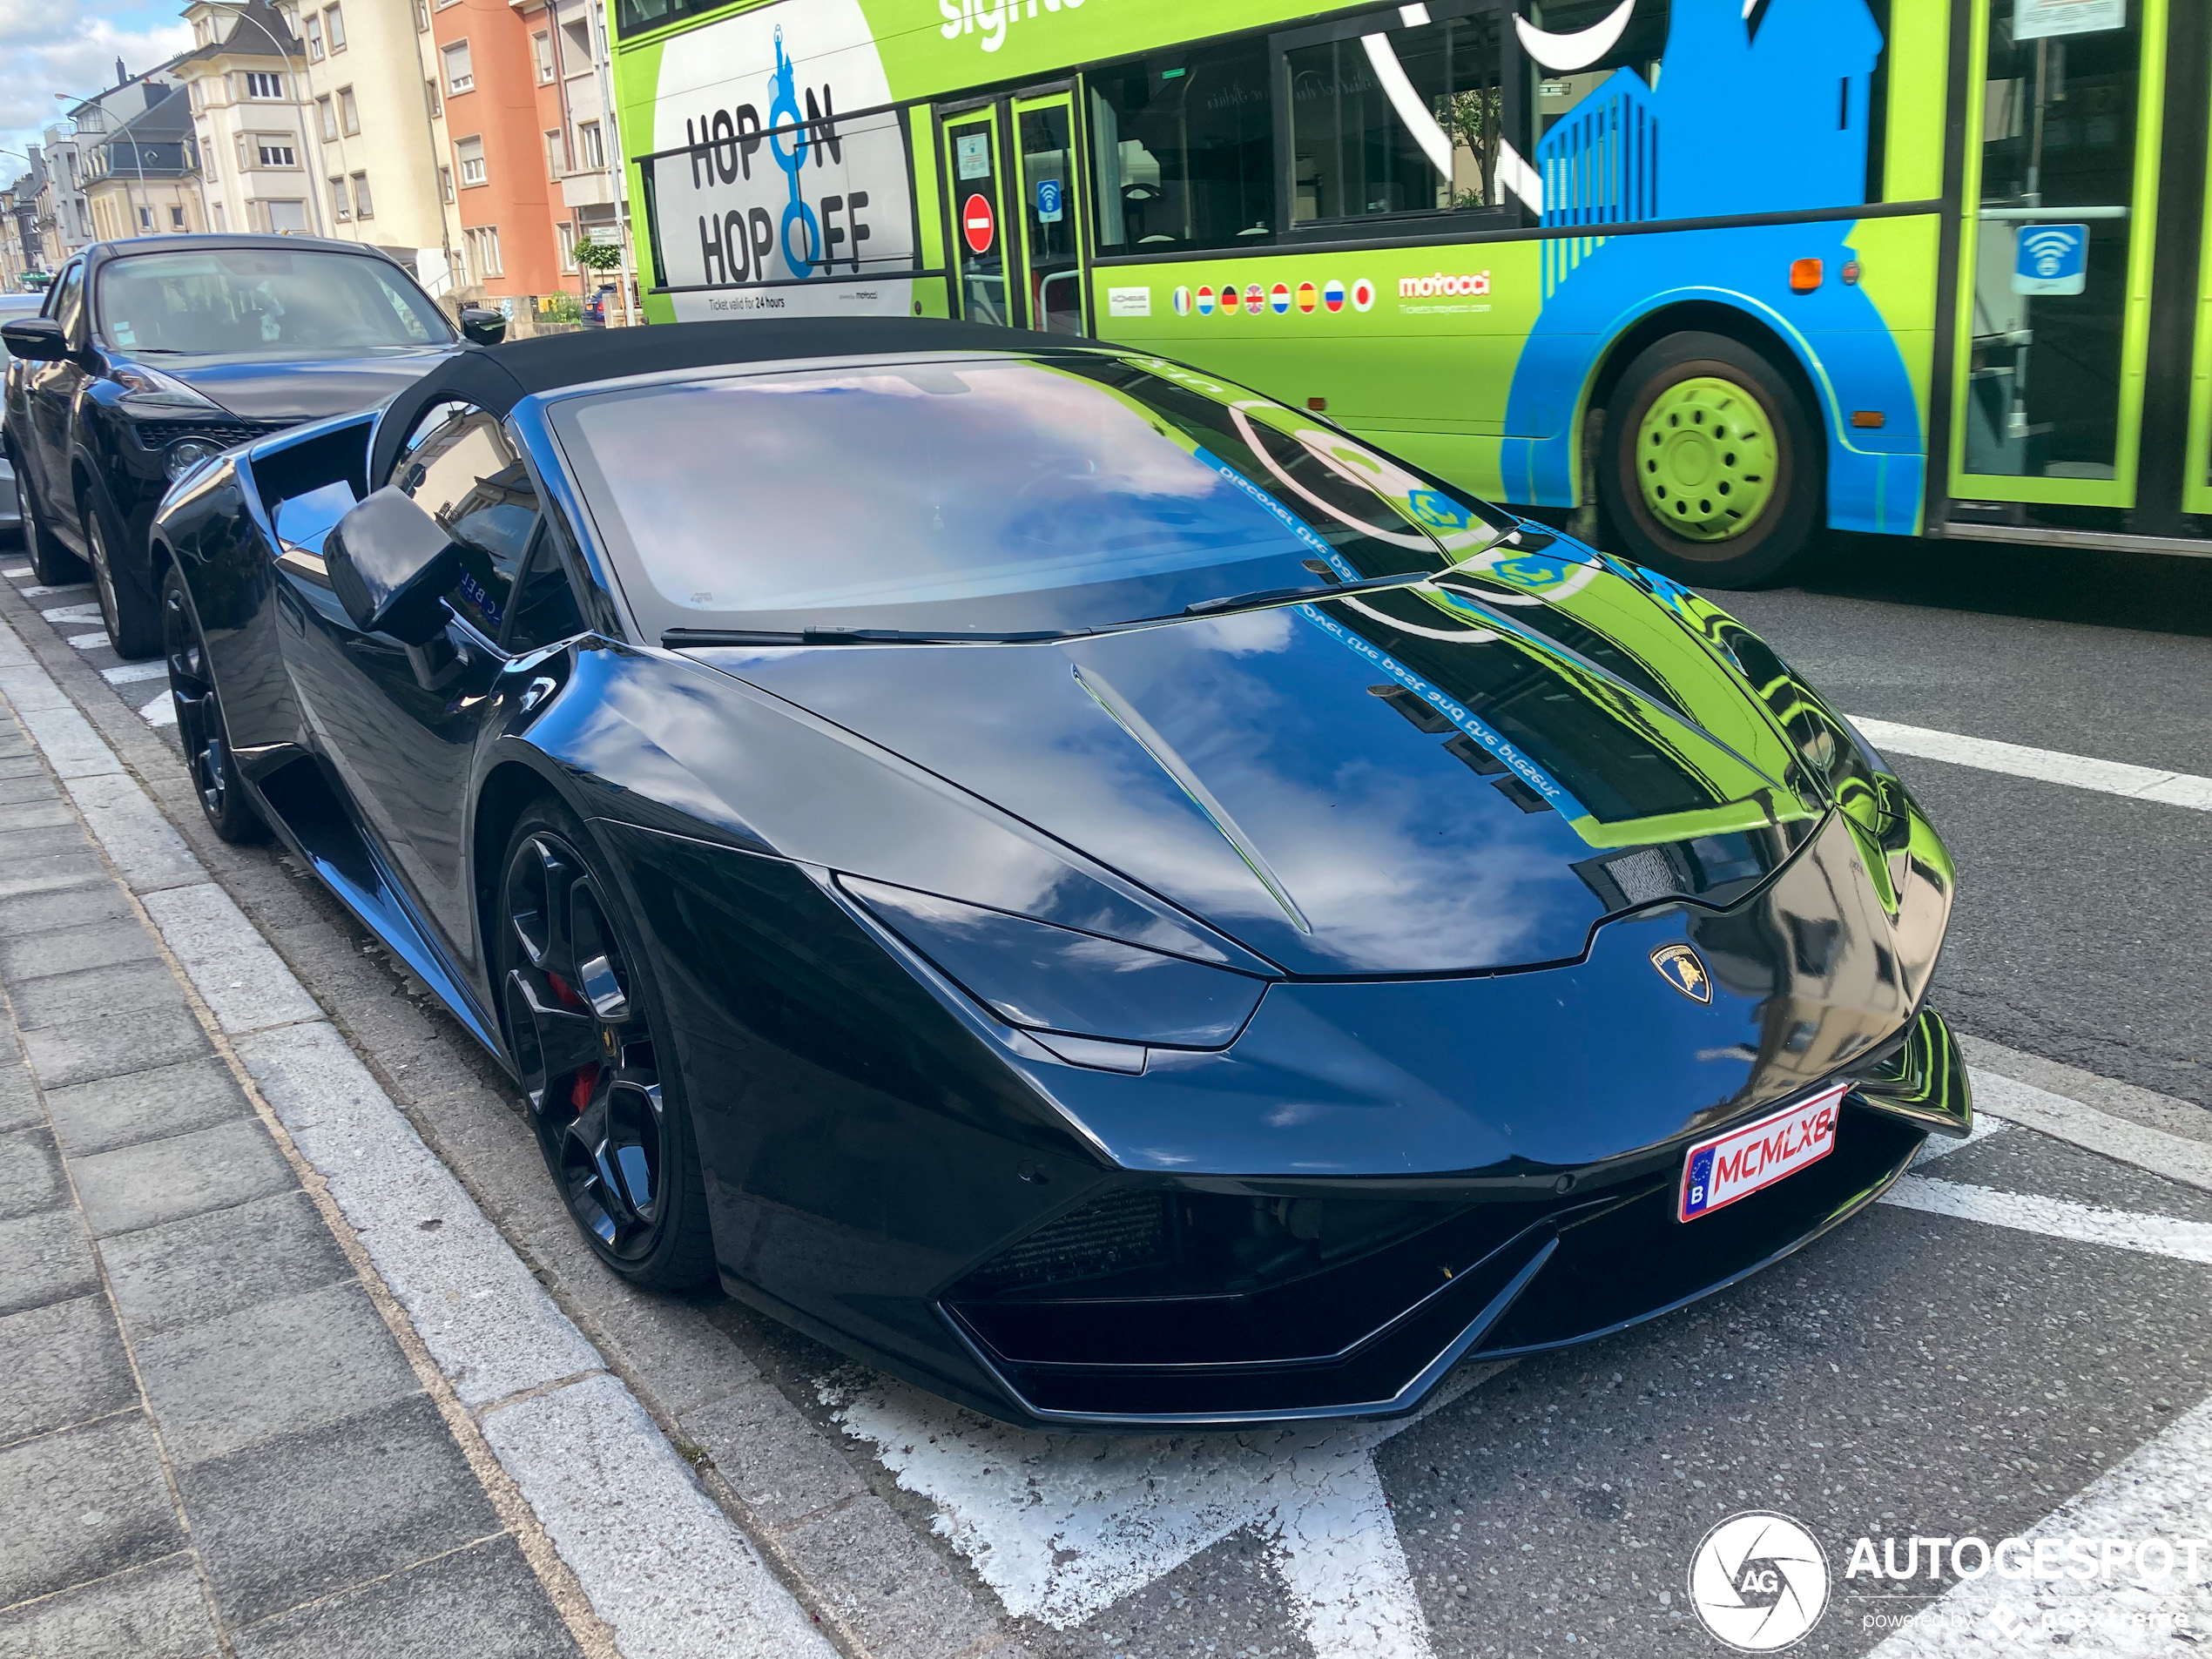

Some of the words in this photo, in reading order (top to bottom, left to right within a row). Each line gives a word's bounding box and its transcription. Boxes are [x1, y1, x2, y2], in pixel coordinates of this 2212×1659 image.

[686, 103, 761, 190] HOP
[769, 83, 841, 175] ON
[698, 206, 772, 285] HOP
[781, 191, 870, 280] OFF
[1399, 269, 1490, 298] motocci
[708, 299, 728, 311] Ticket
[729, 297, 745, 310] valid
[745, 297, 754, 309] for
[755, 297, 765, 308] 24
[765, 296, 785, 308] hours
[1690, 1185, 1703, 1205] B
